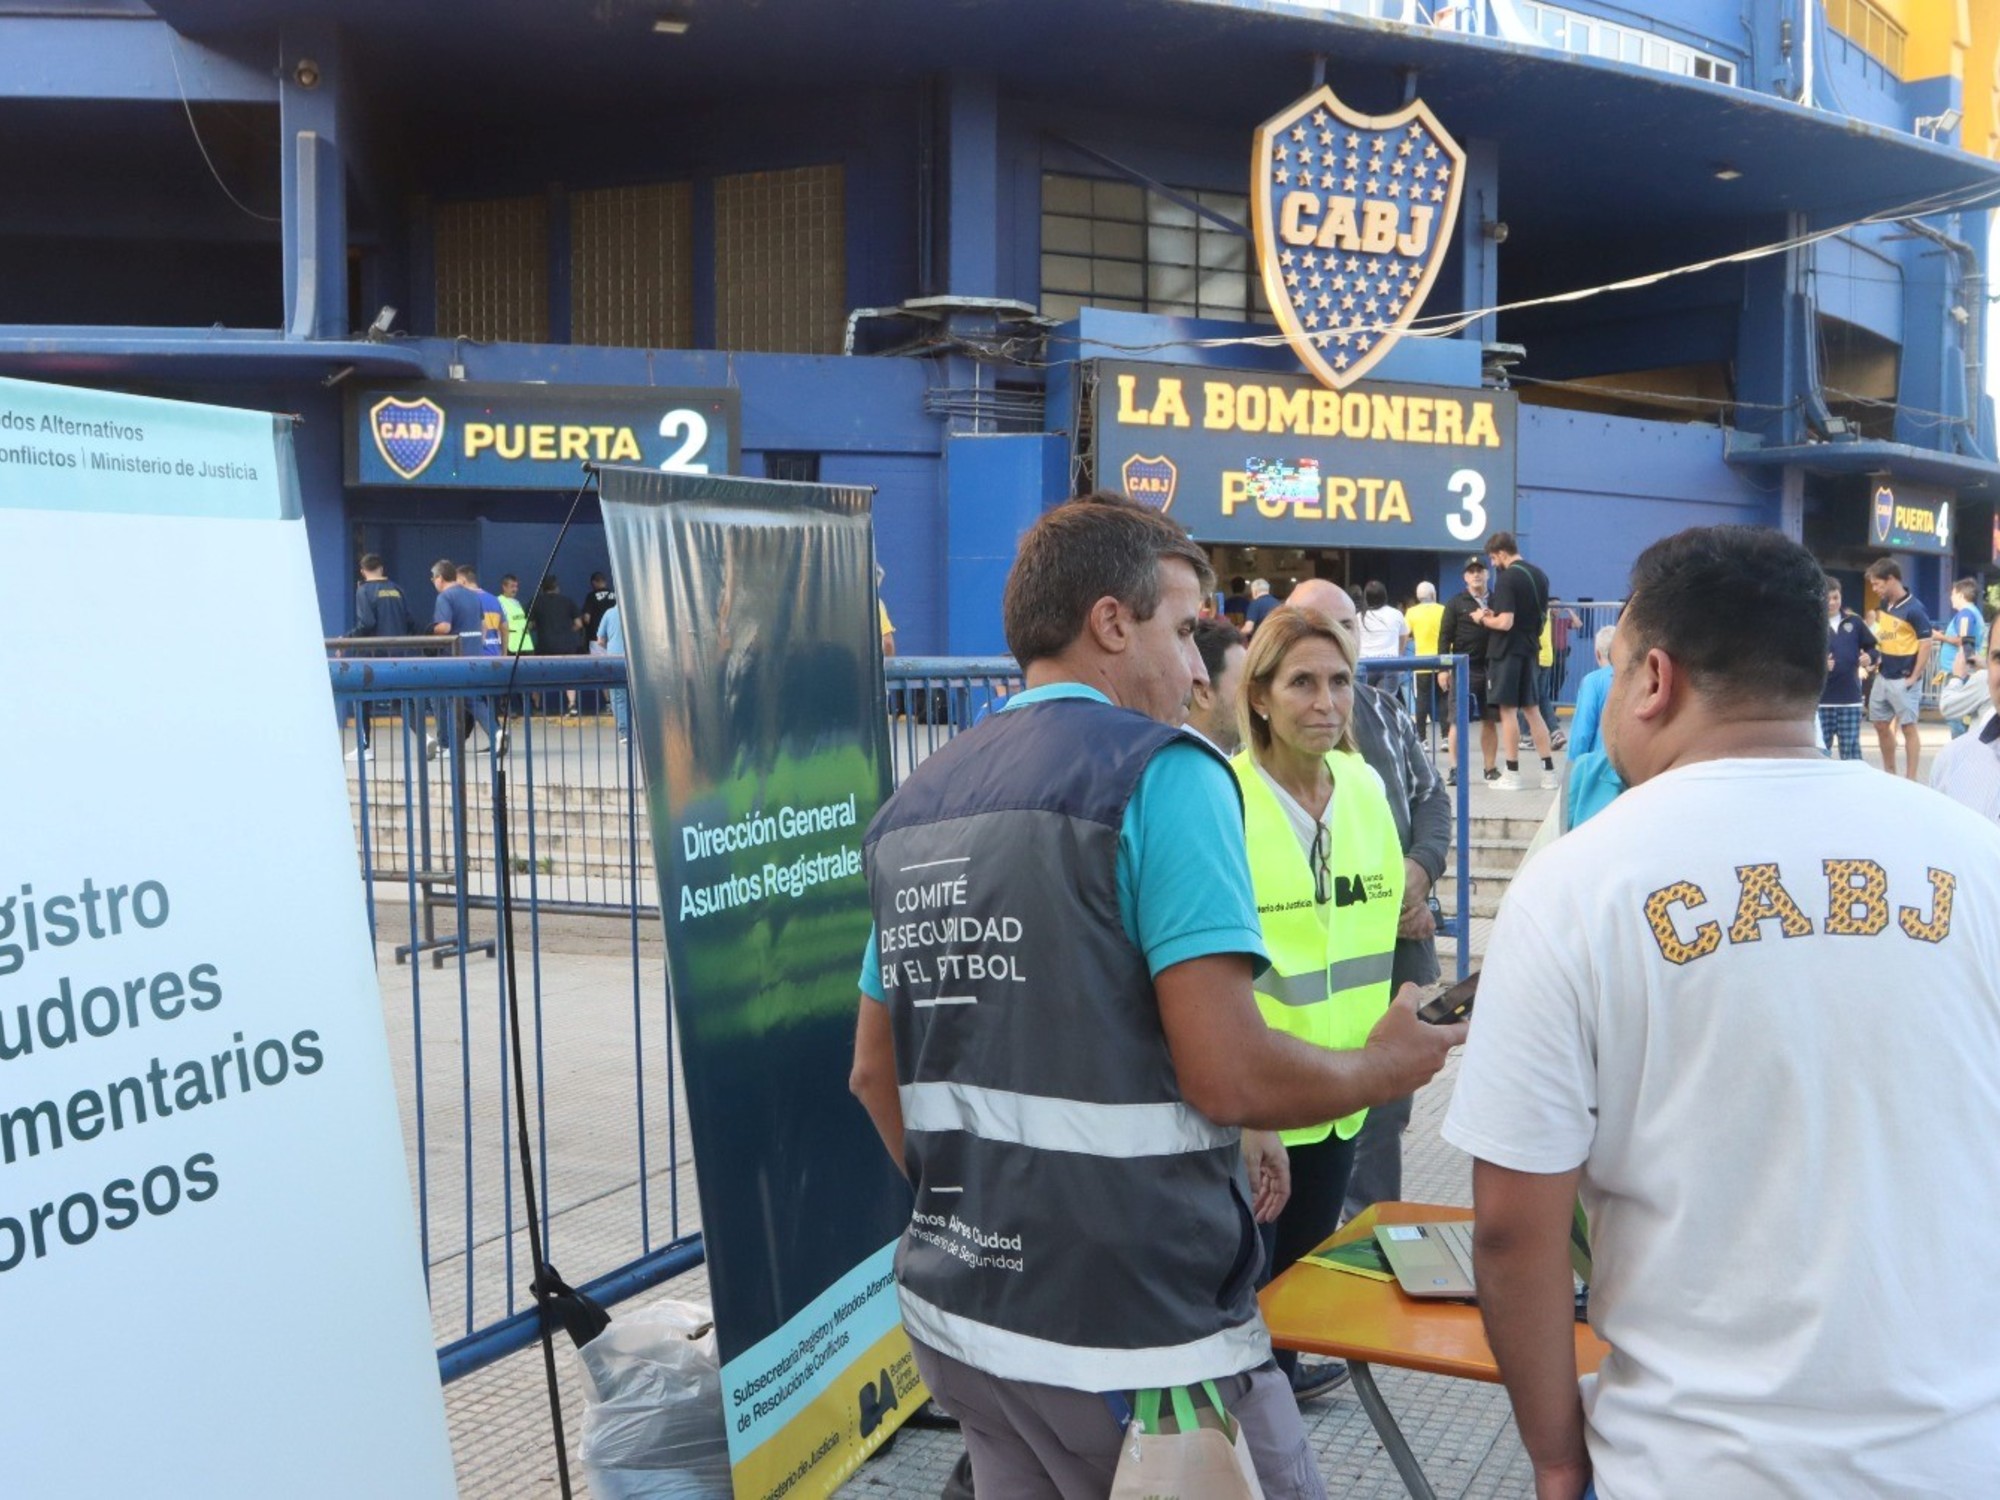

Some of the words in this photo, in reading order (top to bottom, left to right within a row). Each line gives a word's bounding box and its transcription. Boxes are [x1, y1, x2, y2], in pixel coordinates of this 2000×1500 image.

[1280, 190, 1434, 257] CABJ
[40, 414, 144, 441] Alternativos
[381, 422, 434, 440] CABJ
[1117, 374, 1190, 428] LA
[1203, 380, 1501, 448] BOMBONERA
[463, 423, 642, 461] PUERTA
[658, 408, 709, 474] 2
[91, 451, 172, 475] Ministerio
[175, 459, 194, 476] de
[198, 462, 258, 481] Justicia
[1129, 476, 1170, 493] CABJ
[1445, 468, 1488, 541] 3
[1895, 505, 1934, 534] PUERTA
[1936, 501, 1949, 547] 4
[682, 809, 776, 862] Dirección
[778, 793, 856, 838] General
[679, 872, 761, 922] Asuntos
[895, 874, 968, 914] COMITÉ
[1643, 858, 1956, 966] CABJ
[881, 927, 897, 954] DE
[903, 959, 932, 984] EL
[972, 1225, 1022, 1251] Ciudad
[736, 1412, 752, 1434] de
[752, 1367, 804, 1422] Resolución
